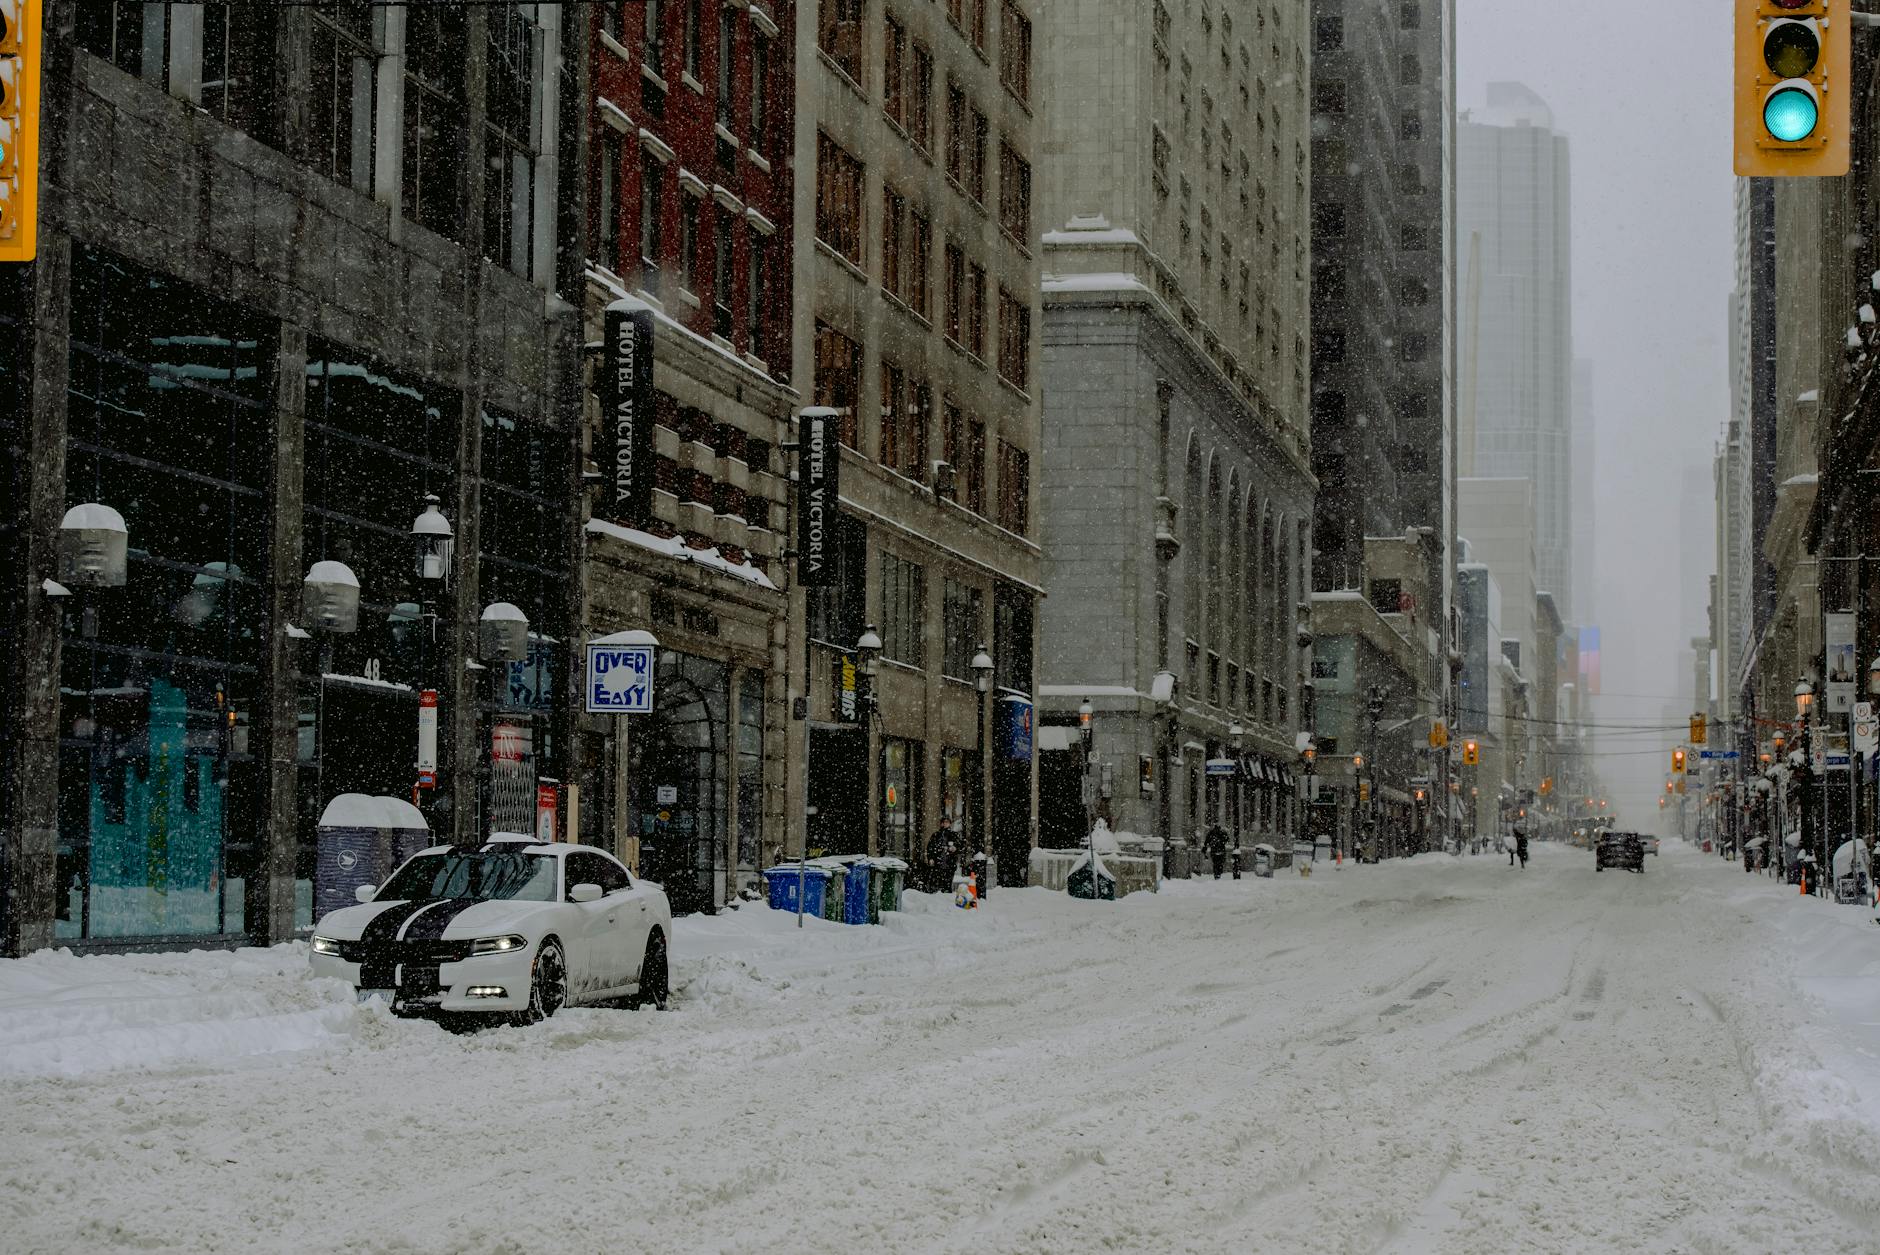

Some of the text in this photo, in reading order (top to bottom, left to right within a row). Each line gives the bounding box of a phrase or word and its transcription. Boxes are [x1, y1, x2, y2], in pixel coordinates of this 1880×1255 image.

[616, 321, 634, 502] HOTEL VICTORIA
[809, 420, 824, 572] HOTEL VICTORIA
[364, 657, 380, 681] 48
[596, 652, 647, 674] OVER
[594, 683, 646, 706] EASY
[841, 655, 856, 720] SUBWAY
